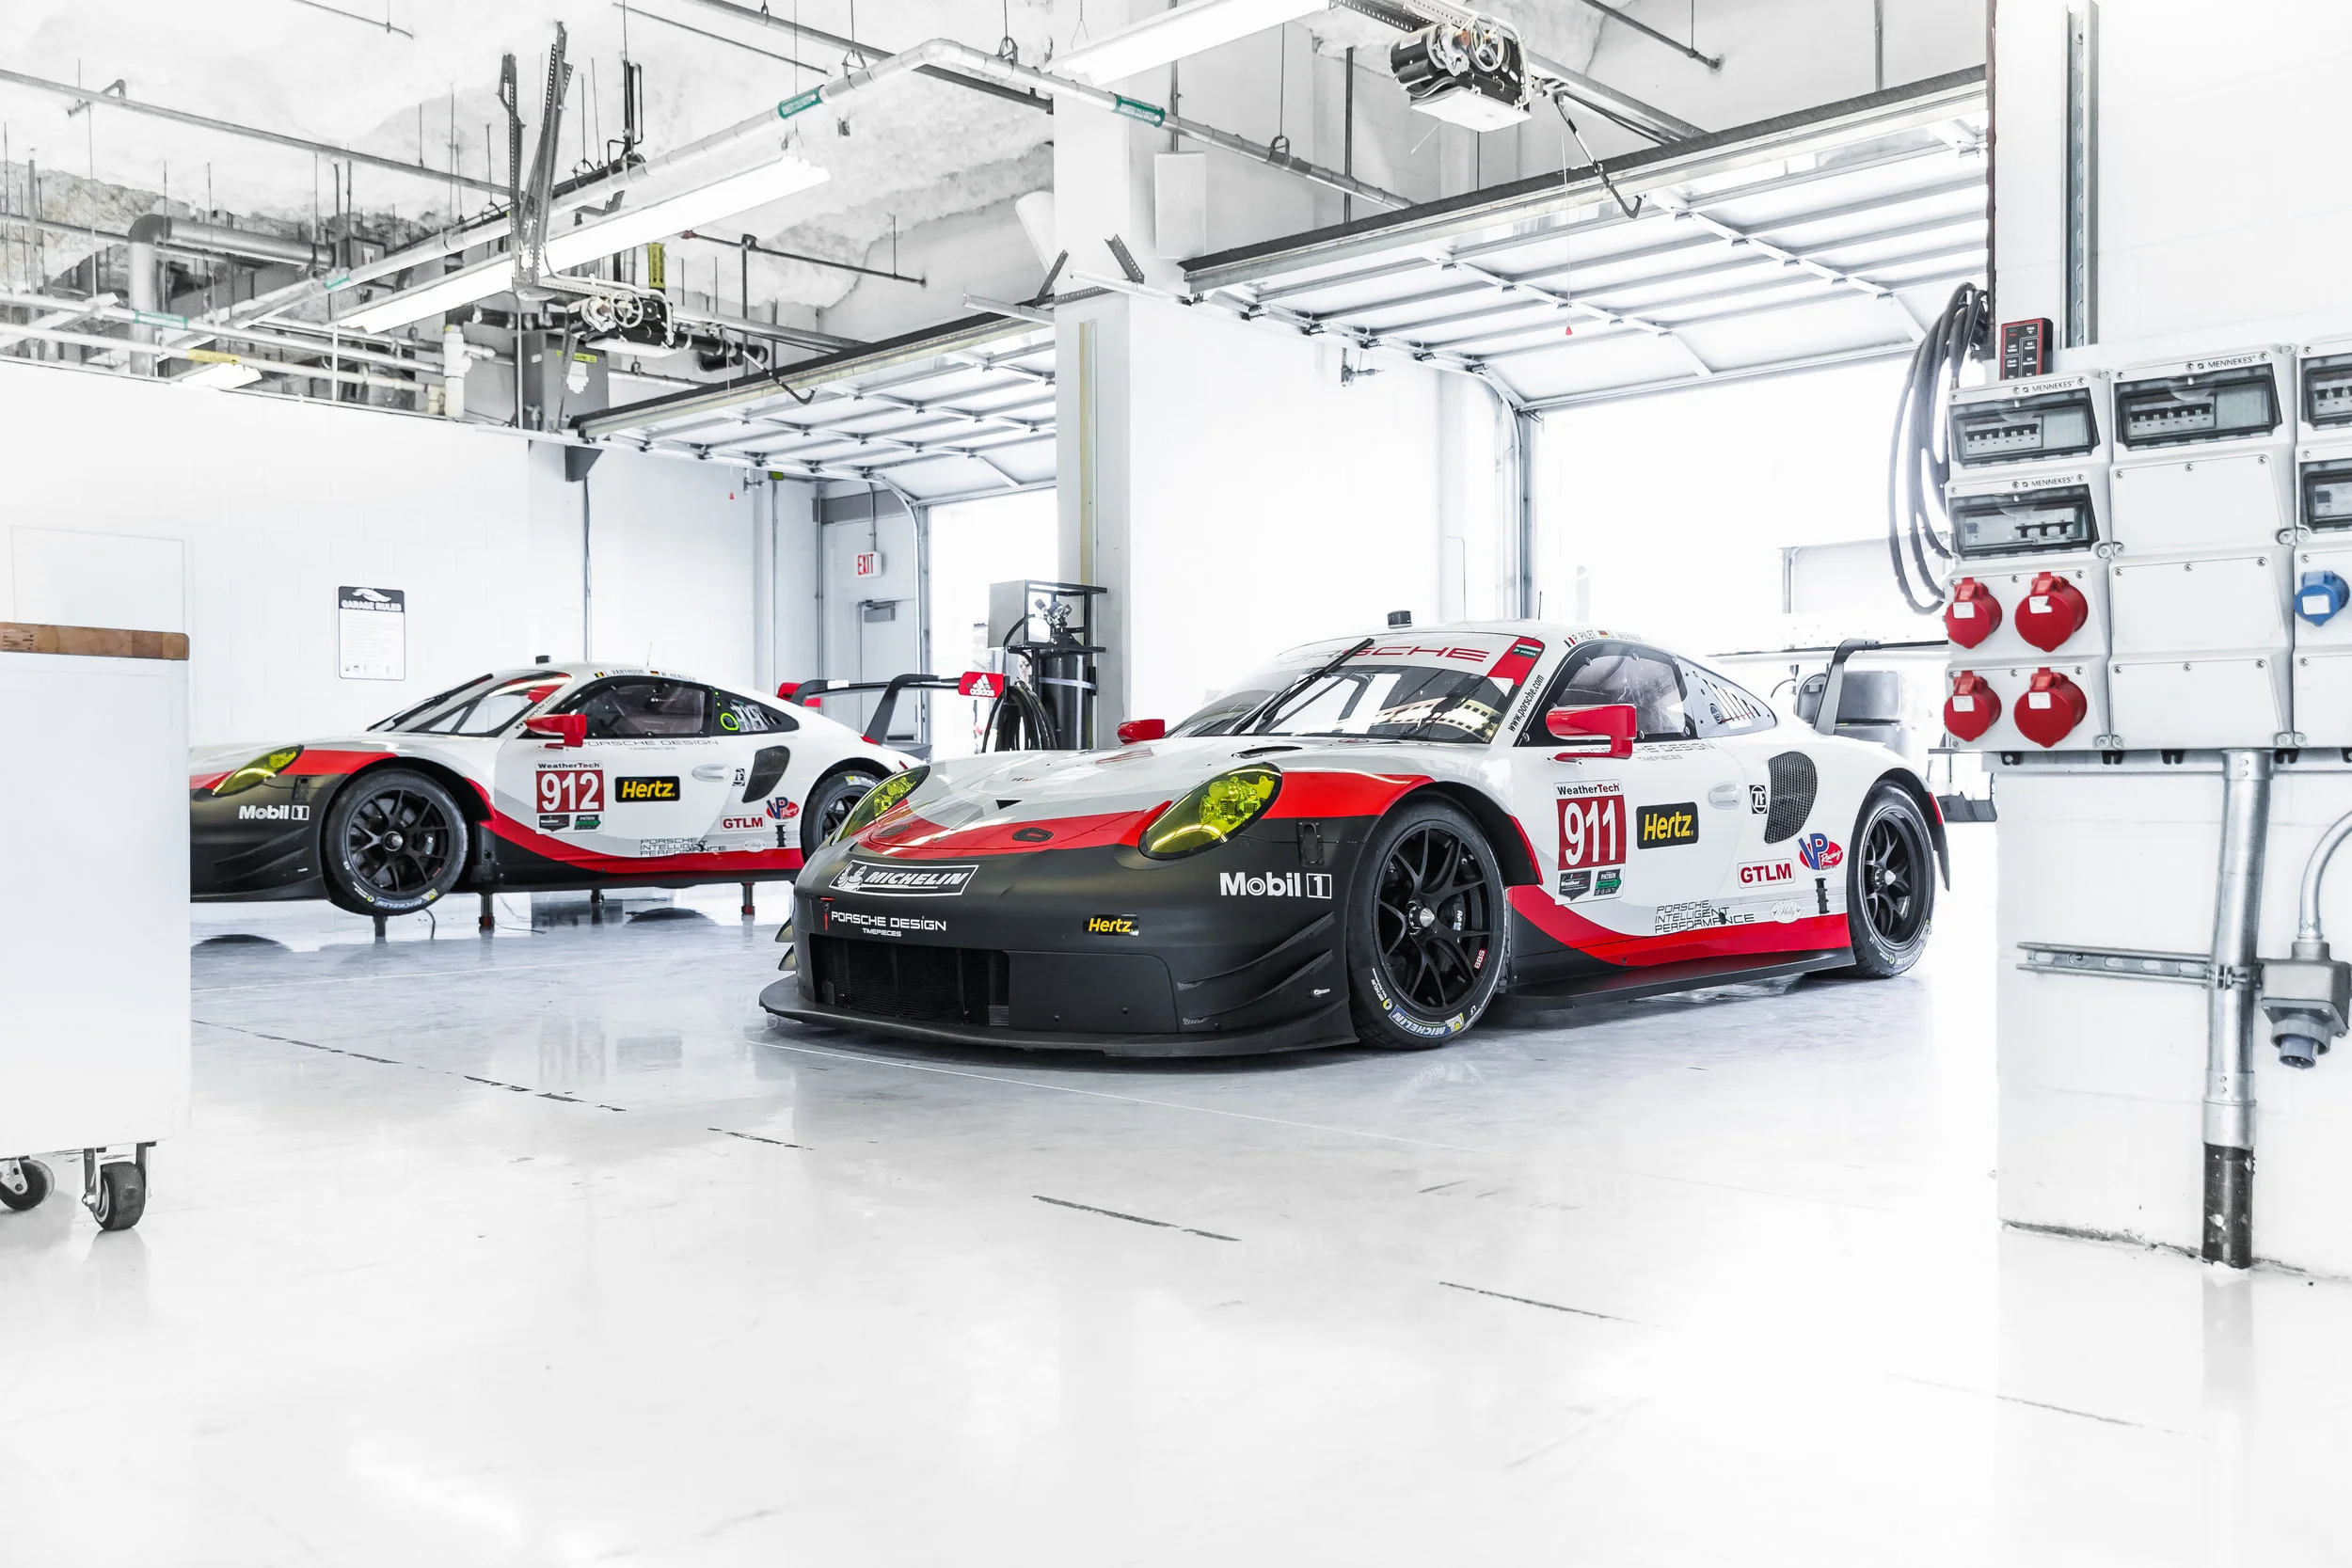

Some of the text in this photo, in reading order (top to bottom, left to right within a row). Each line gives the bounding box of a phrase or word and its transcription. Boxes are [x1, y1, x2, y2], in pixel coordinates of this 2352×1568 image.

[2206, 356, 2254, 370] MENNEKES
[2032, 381, 2072, 392] MENNEKES
[2031, 476, 2072, 487] MENNEKES
[857, 554, 874, 576] EXIT
[970, 687, 995, 697] adidas
[1507, 673, 1545, 733] www.porsche.com
[1659, 739, 1715, 752] DESIGN
[540, 772, 599, 811] 912
[622, 781, 674, 798] Hertz
[1557, 784, 1619, 796] WeatherTech
[239, 805, 290, 819] Mobil
[723, 817, 763, 829] GTLM
[1644, 812, 1692, 841] Hertz
[1565, 800, 1616, 865] 911
[1798, 832, 1828, 870] VP
[865, 871, 969, 885] MICHELIN
[1740, 863, 1792, 883] GTLM
[1219, 872, 1301, 896] Mobil
[1655, 899, 1709, 914] PORSCHE
[831, 911, 946, 931] PORSCHE DESIGN
[1089, 917, 1133, 933] Hertz
[862, 927, 902, 937] TIMEPIECES
[1391, 1011, 1446, 1035] MICHELIN
